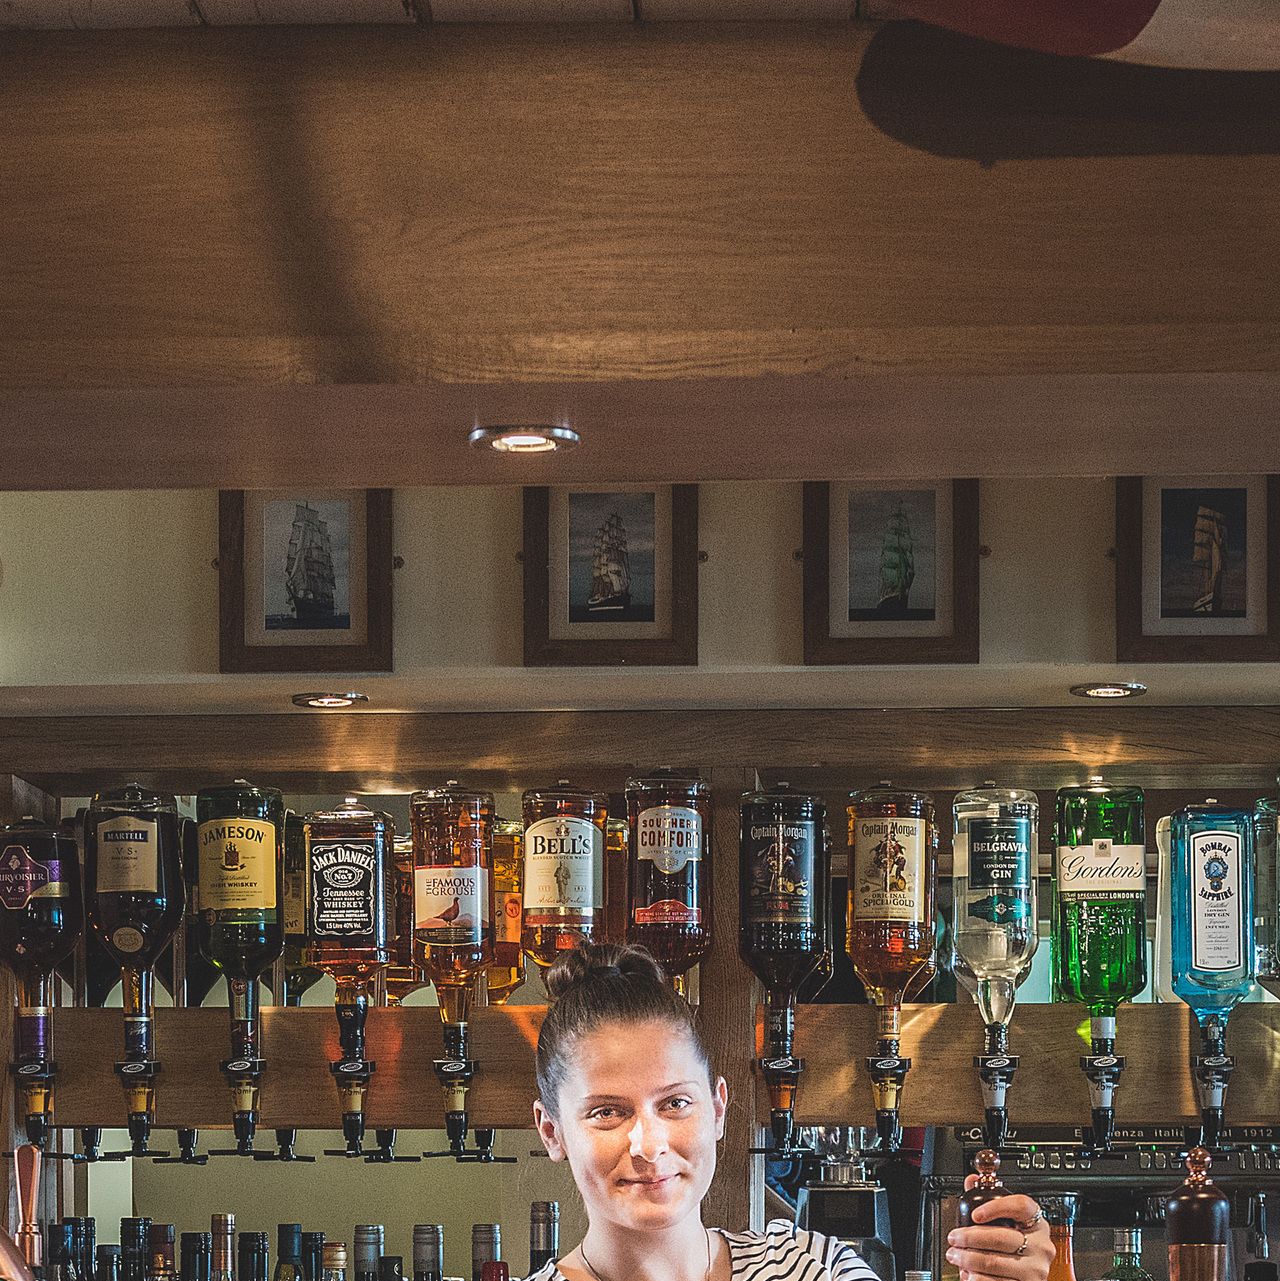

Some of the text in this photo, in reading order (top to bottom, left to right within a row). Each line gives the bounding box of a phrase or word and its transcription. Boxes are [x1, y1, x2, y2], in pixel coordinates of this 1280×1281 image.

[642, 818, 698, 829] SOUTHERN
[107, 831, 145, 841] MARTELL
[202, 826, 265, 846] JAMESON
[751, 824, 776, 840] Captain
[862, 823, 888, 838] Captain
[532, 834, 593, 856] BELL'S
[973, 841, 1027, 853] BELGRAVIA
[1200, 842, 1232, 857] BOMBAY
[312, 847, 376, 871] JACK DANIEL'S
[1061, 855, 1144, 881] Gordon's
[991, 869, 1012, 879] GIN
[432, 877, 476, 888] FAMOUS
[323, 888, 365, 897] Tennessee
[431, 886, 476, 897] GROUSE
[1109, 892, 1132, 900] LONDON
[1199, 887, 1235, 901] SAPPHIRE
[892, 898, 915, 908] GOLD
[1243, 1129, 1274, 1138] 1912
